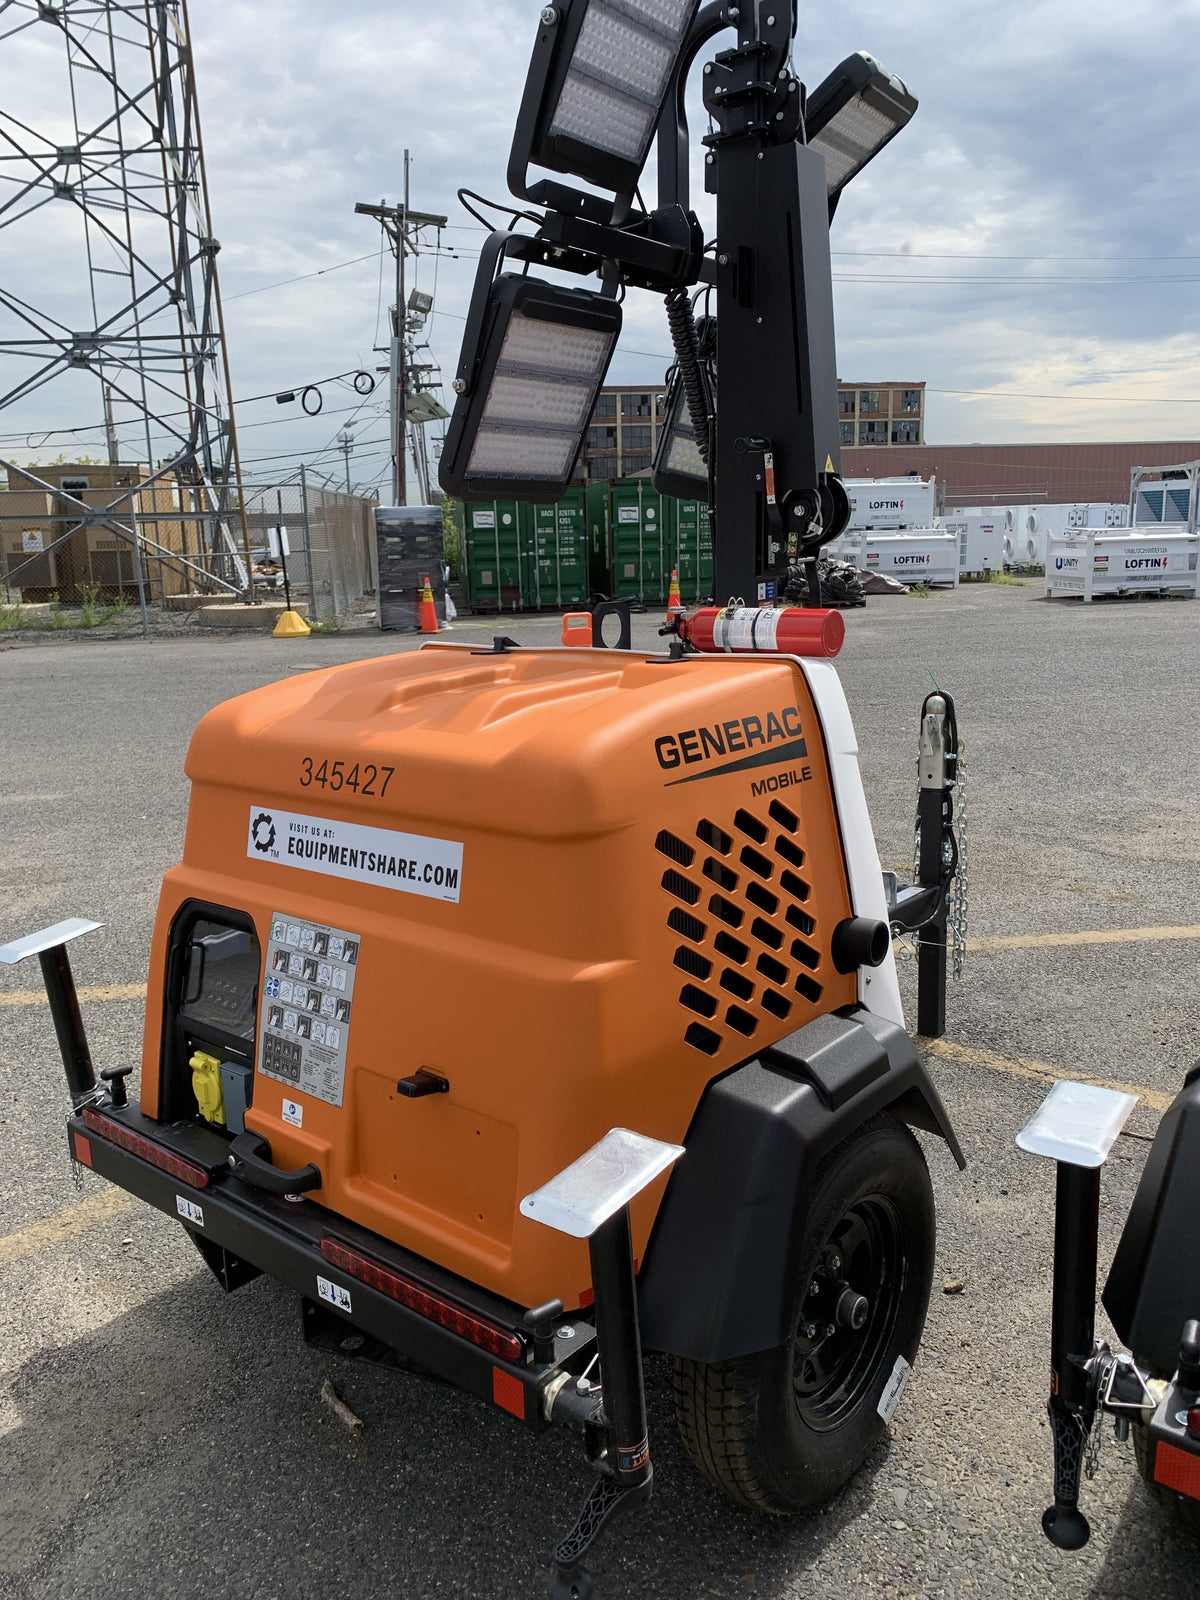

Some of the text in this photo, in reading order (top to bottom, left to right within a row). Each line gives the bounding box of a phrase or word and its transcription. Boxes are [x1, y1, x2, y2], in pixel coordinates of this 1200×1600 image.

[869, 501, 899, 509] LOFTIN
[893, 555, 925, 564] LOFTIN
[1063, 558, 1079, 567] UNITY
[1125, 558, 1161, 569] LOFTIN
[654, 706, 803, 769] GENERAC
[299, 756, 395, 797] 345427
[751, 766, 812, 797] MOBILE
[289, 822, 336, 840] VISIT US AT:
[287, 836, 458, 889] EQUIPMENTSHARE.COM
